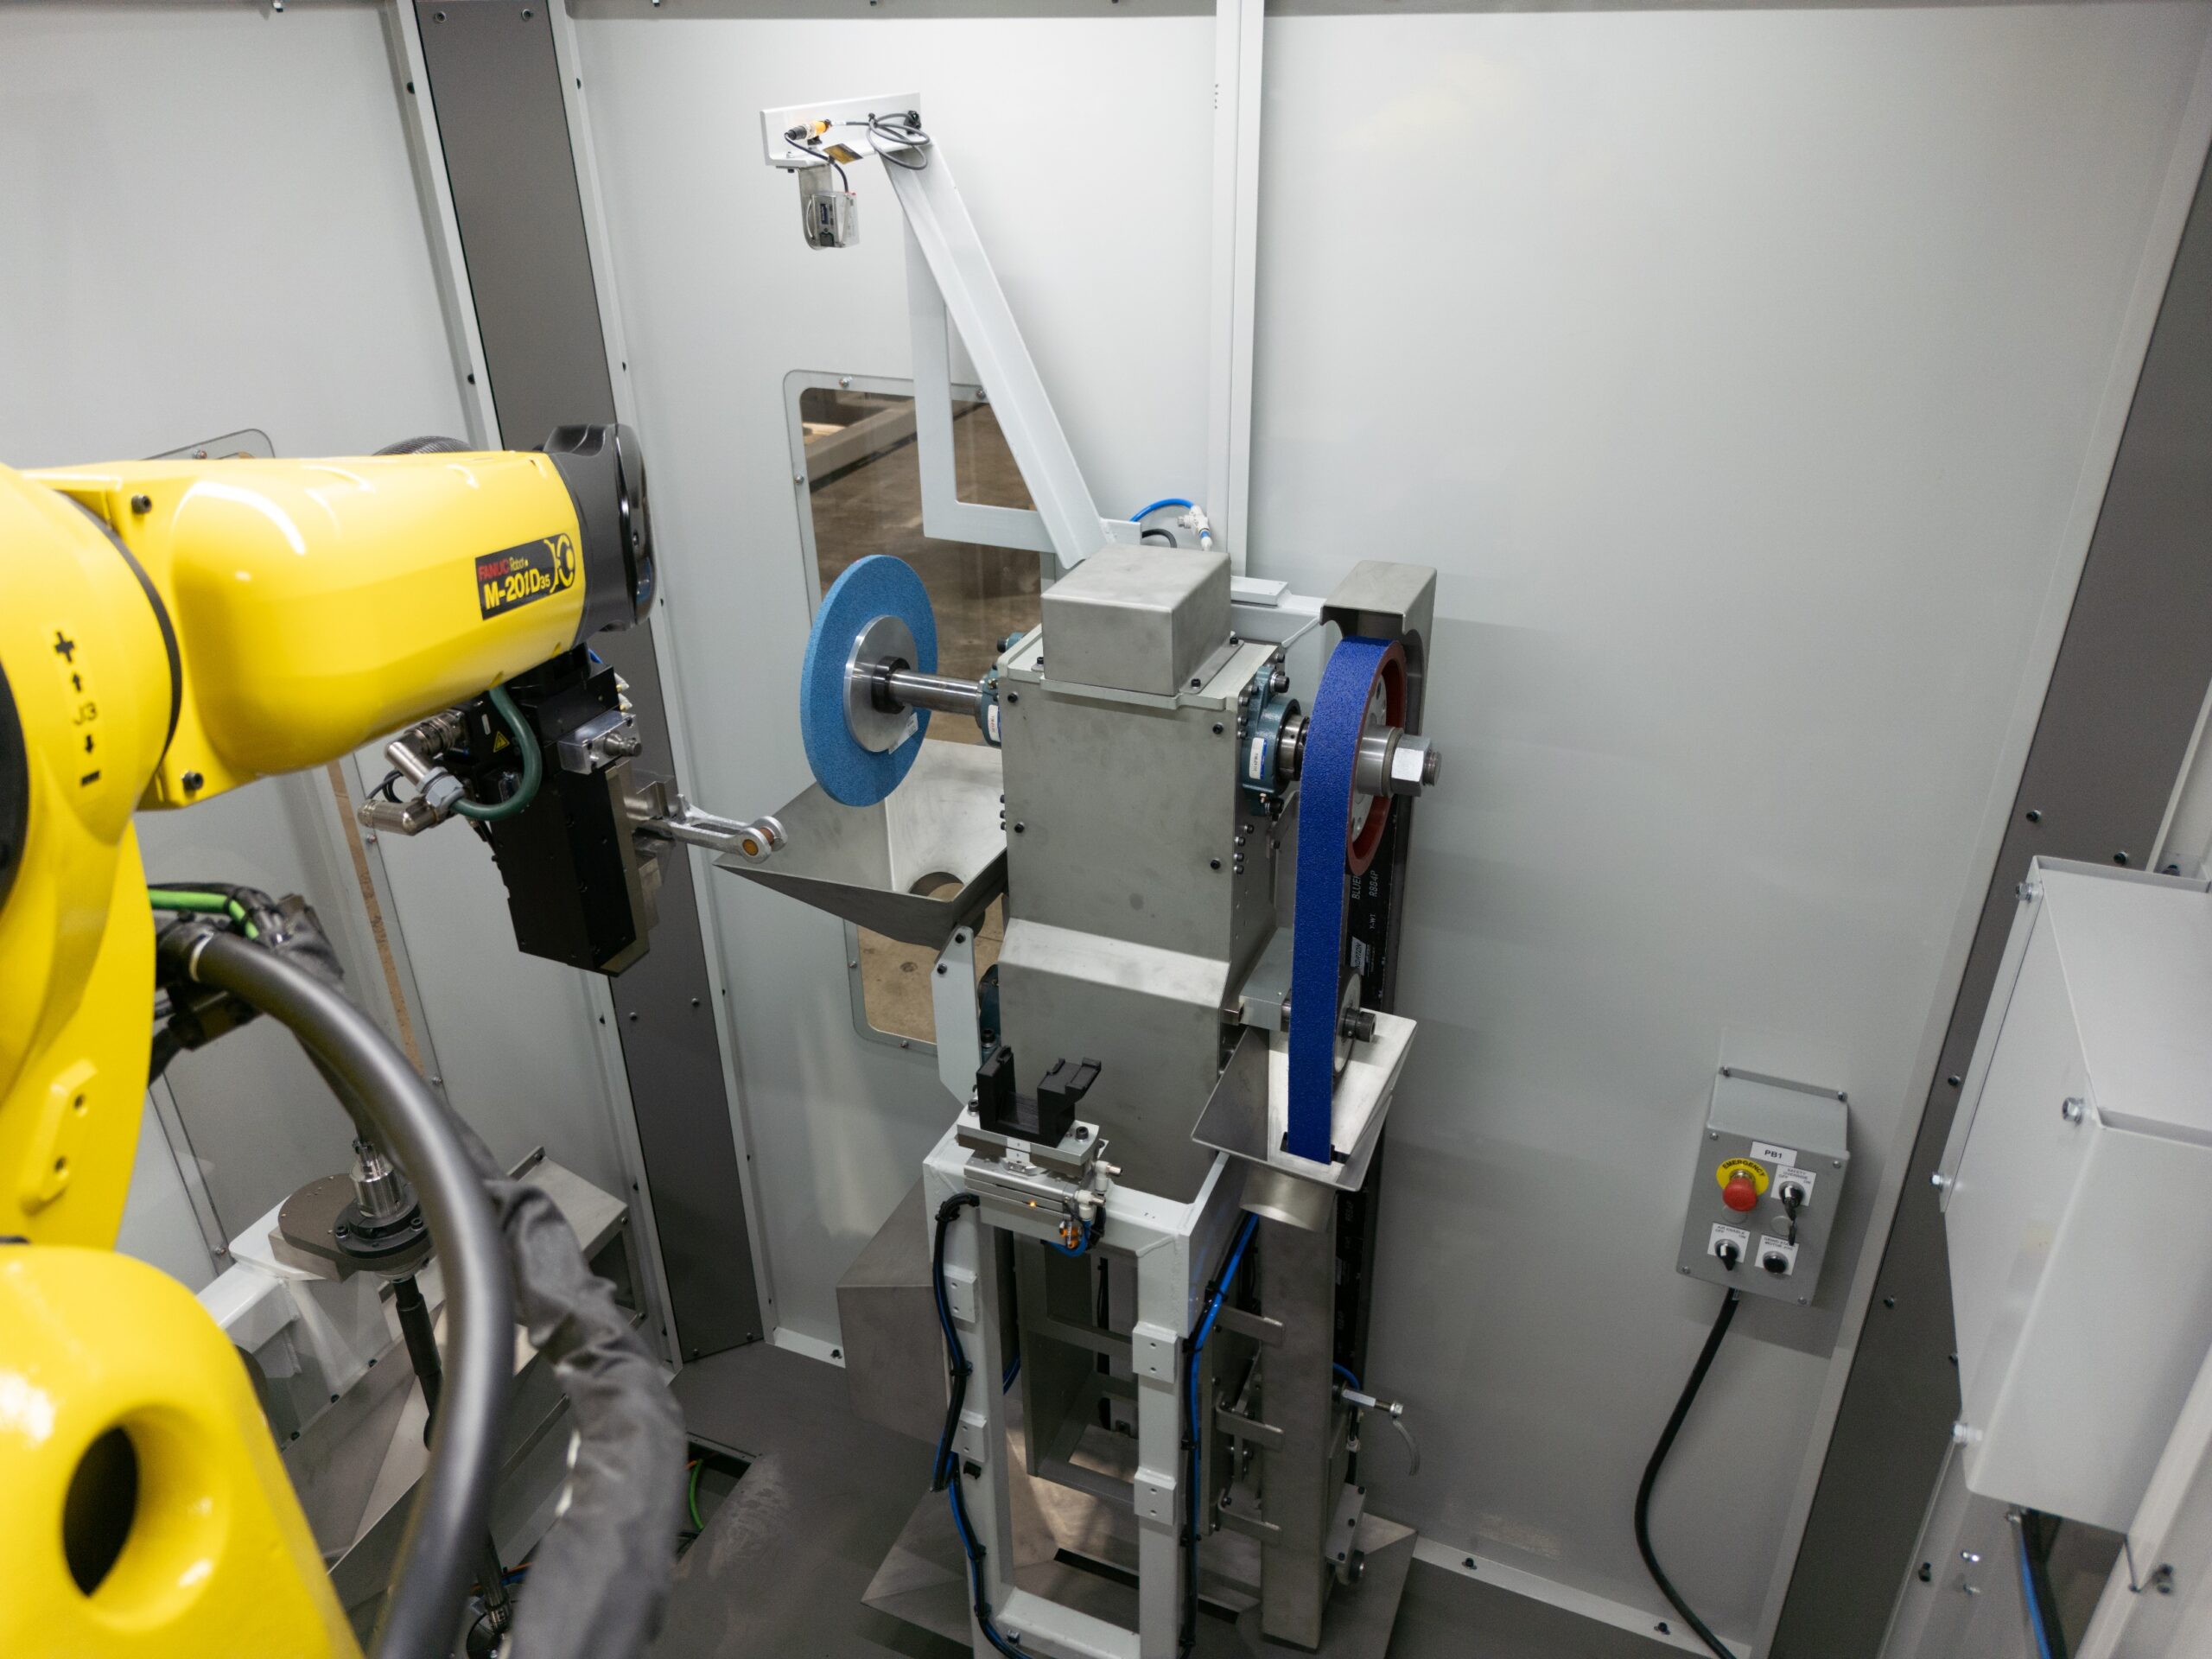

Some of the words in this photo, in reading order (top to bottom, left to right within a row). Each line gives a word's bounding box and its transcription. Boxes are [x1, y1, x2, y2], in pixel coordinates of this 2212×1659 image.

[478, 558, 509, 582] FANUC
[73, 702, 98, 727] J3
[1764, 1149, 1783, 1159] PB1
[1722, 1160, 1765, 1177] EMERGENCY
